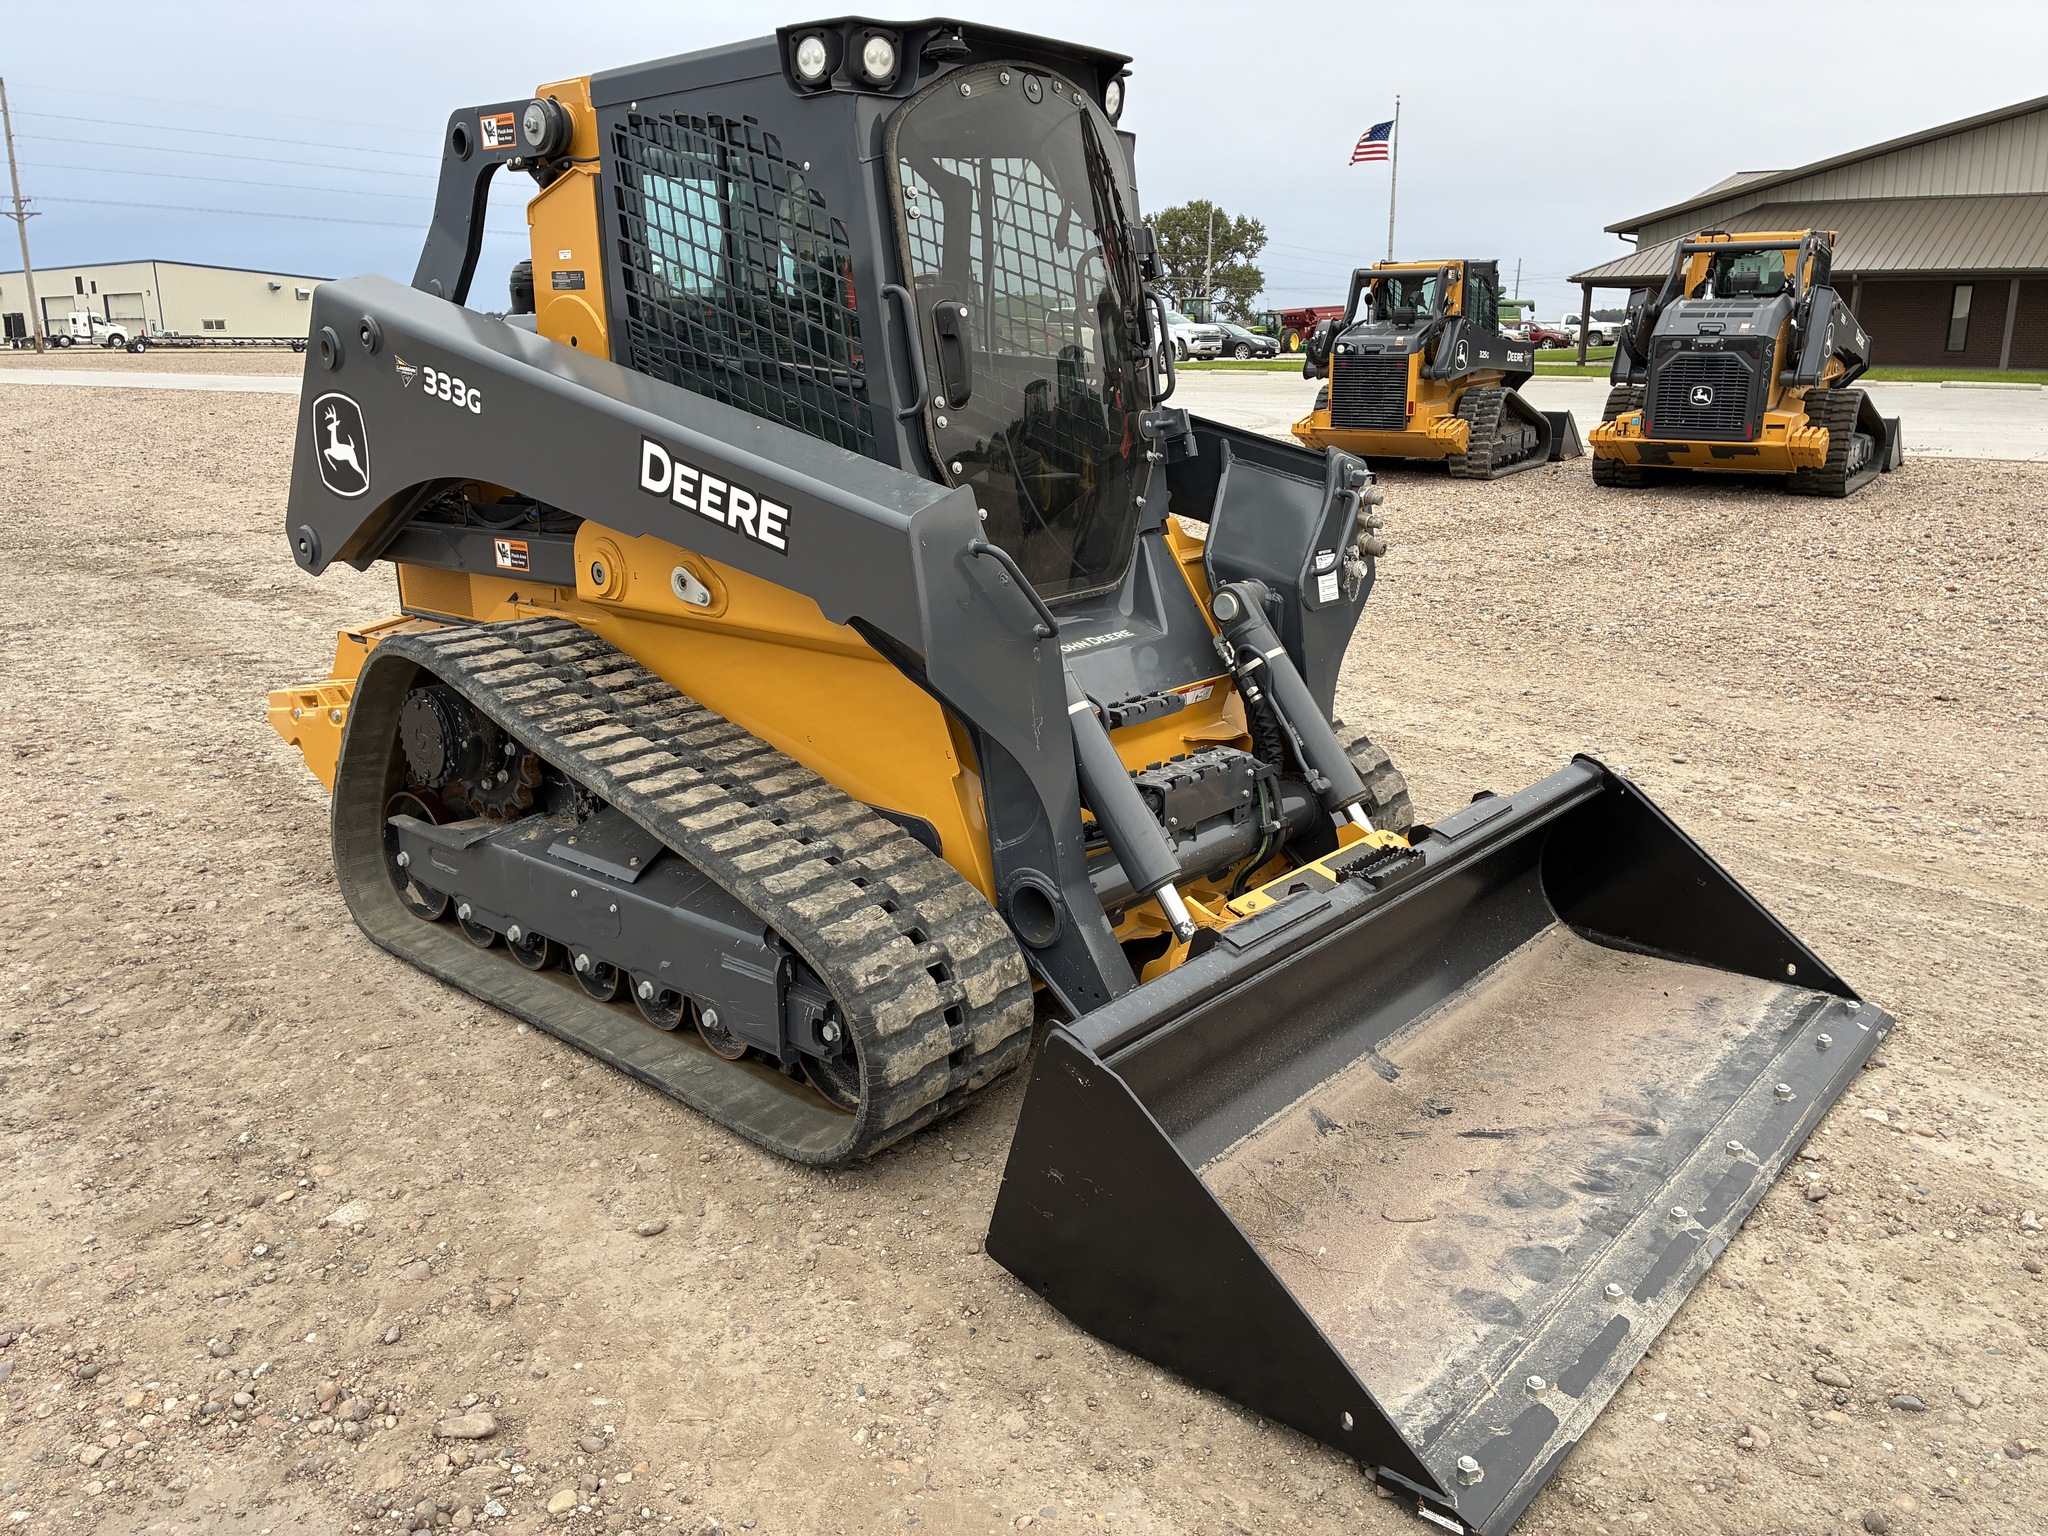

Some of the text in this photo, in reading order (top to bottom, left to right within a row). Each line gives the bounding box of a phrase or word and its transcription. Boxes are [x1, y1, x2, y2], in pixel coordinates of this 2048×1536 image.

[1506, 350, 1524, 362] DEERE
[423, 366, 481, 414] 333G
[641, 440, 788, 551] DEERE
[1060, 629, 1135, 652] OHN DEERE
